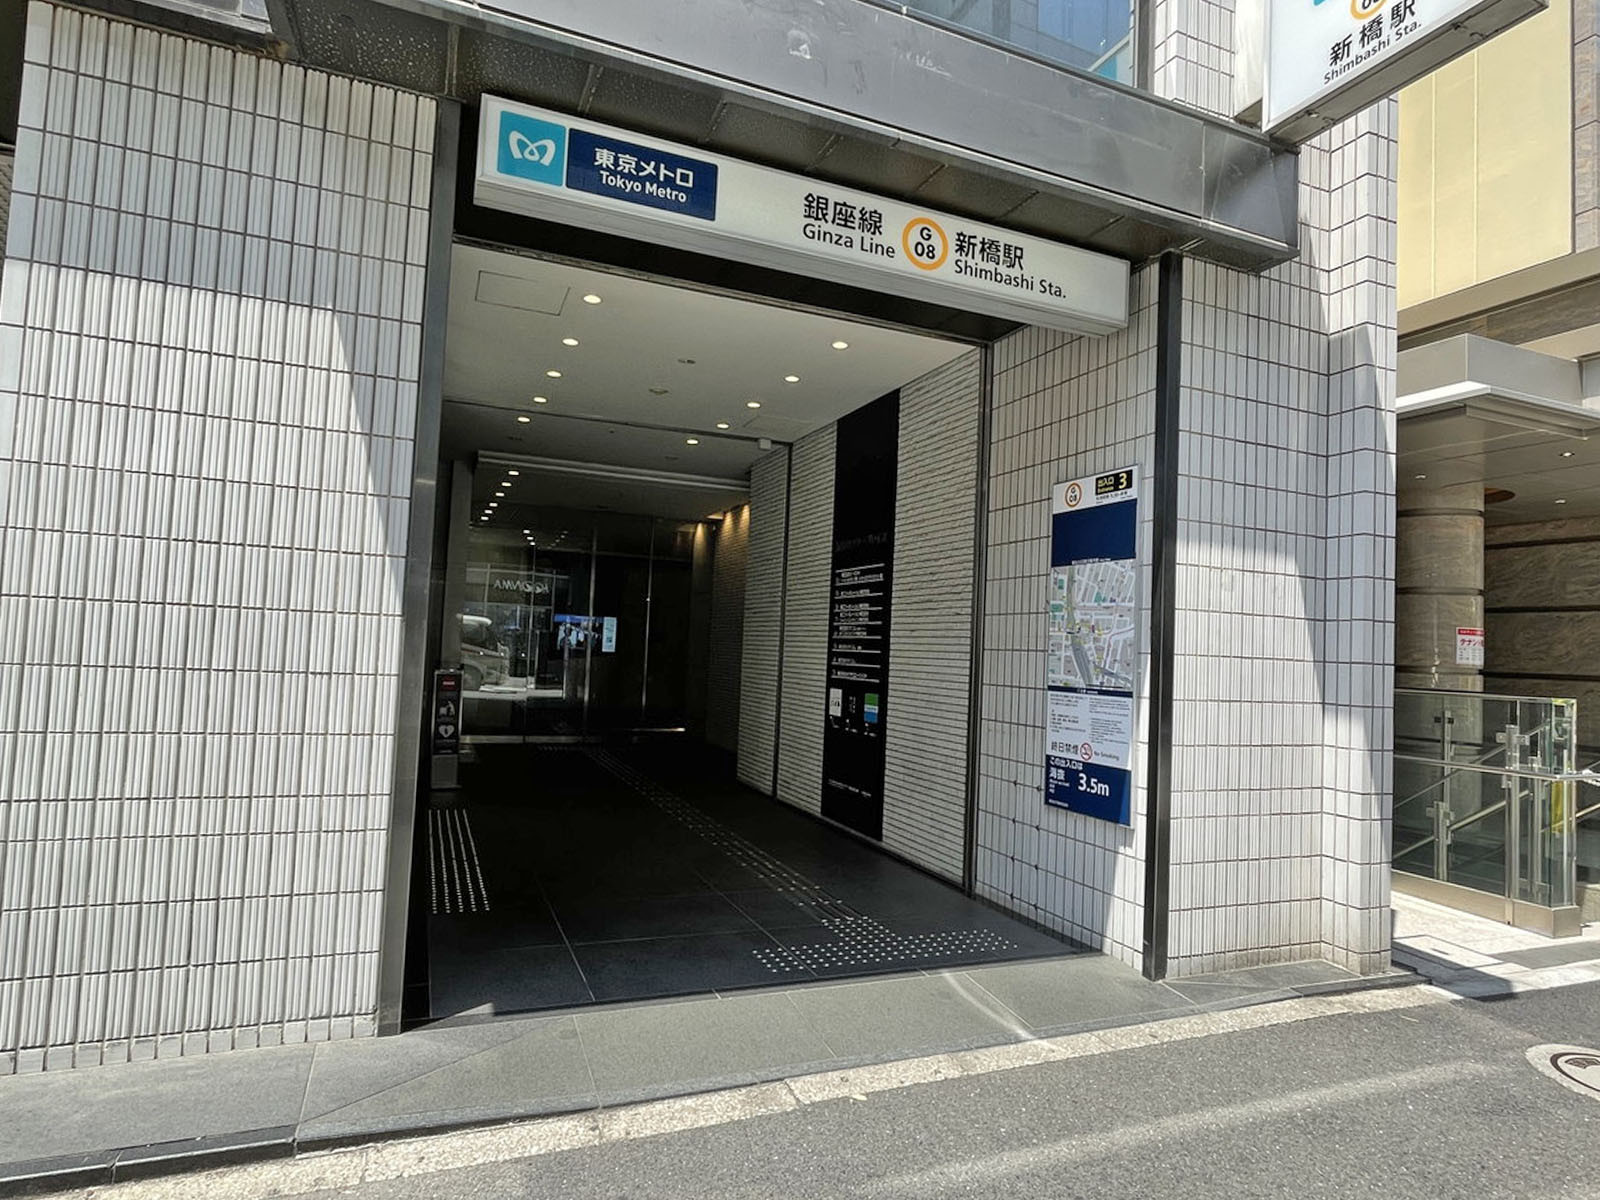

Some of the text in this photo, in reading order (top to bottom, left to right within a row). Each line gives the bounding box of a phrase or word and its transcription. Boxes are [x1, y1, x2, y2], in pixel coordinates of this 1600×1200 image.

[1329, 0, 1415, 67] 新橋駅
[1324, 21, 1422, 85] Shimbashi Sta.
[593, 147, 694, 188] 東京メトロ
[600, 170, 687, 203] Tokyo Metro
[803, 193, 883, 236] 銀座線
[803, 223, 896, 258] Ginza Line
[914, 241, 936, 260] 08
[919, 227, 932, 241] G
[955, 231, 1024, 271] 新橋駅
[954, 260, 1067, 299] Shimbashi Sta.
[1119, 472, 1127, 489] 3
[1078, 773, 1110, 797] 3.5m
